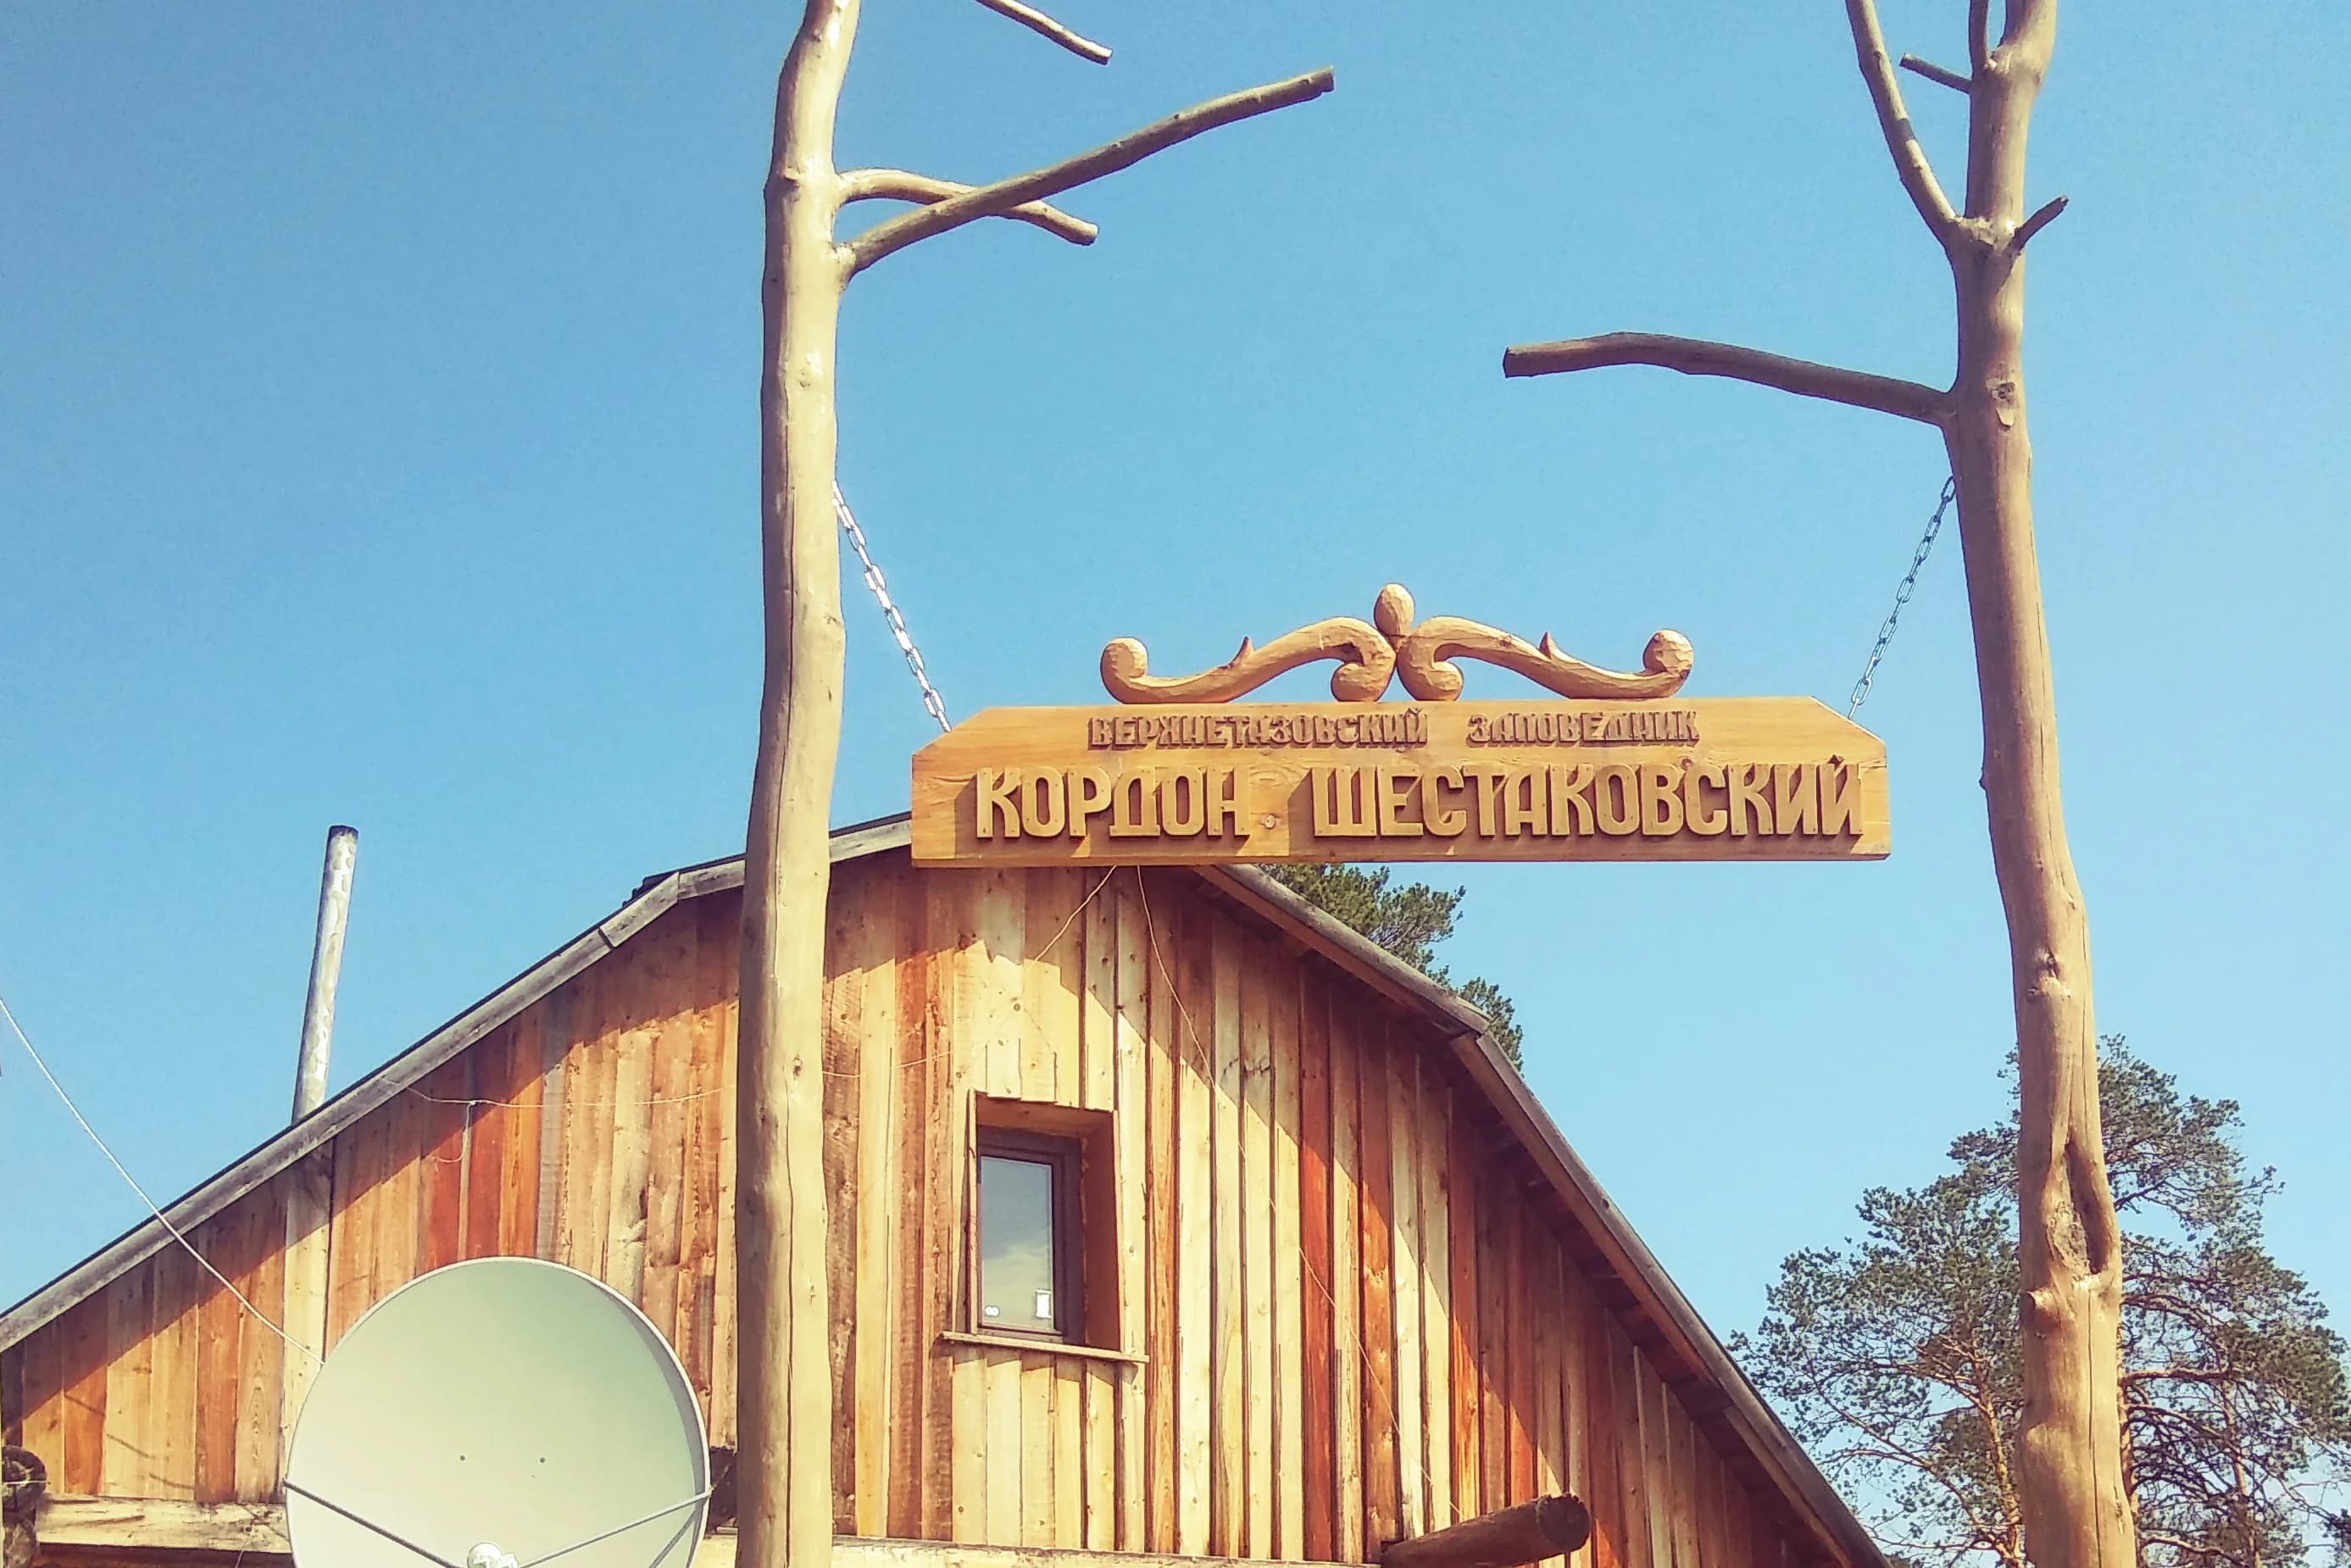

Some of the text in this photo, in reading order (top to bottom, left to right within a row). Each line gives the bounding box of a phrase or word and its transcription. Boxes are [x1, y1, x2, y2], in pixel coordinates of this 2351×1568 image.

[1090, 707, 1700, 749] ВЕРХНЕТАЗОВСКИЙ ЗАПОВЕДНИК
[976, 754, 1864, 839] КОРДОН ШЕСТАКОВСКИЙ
